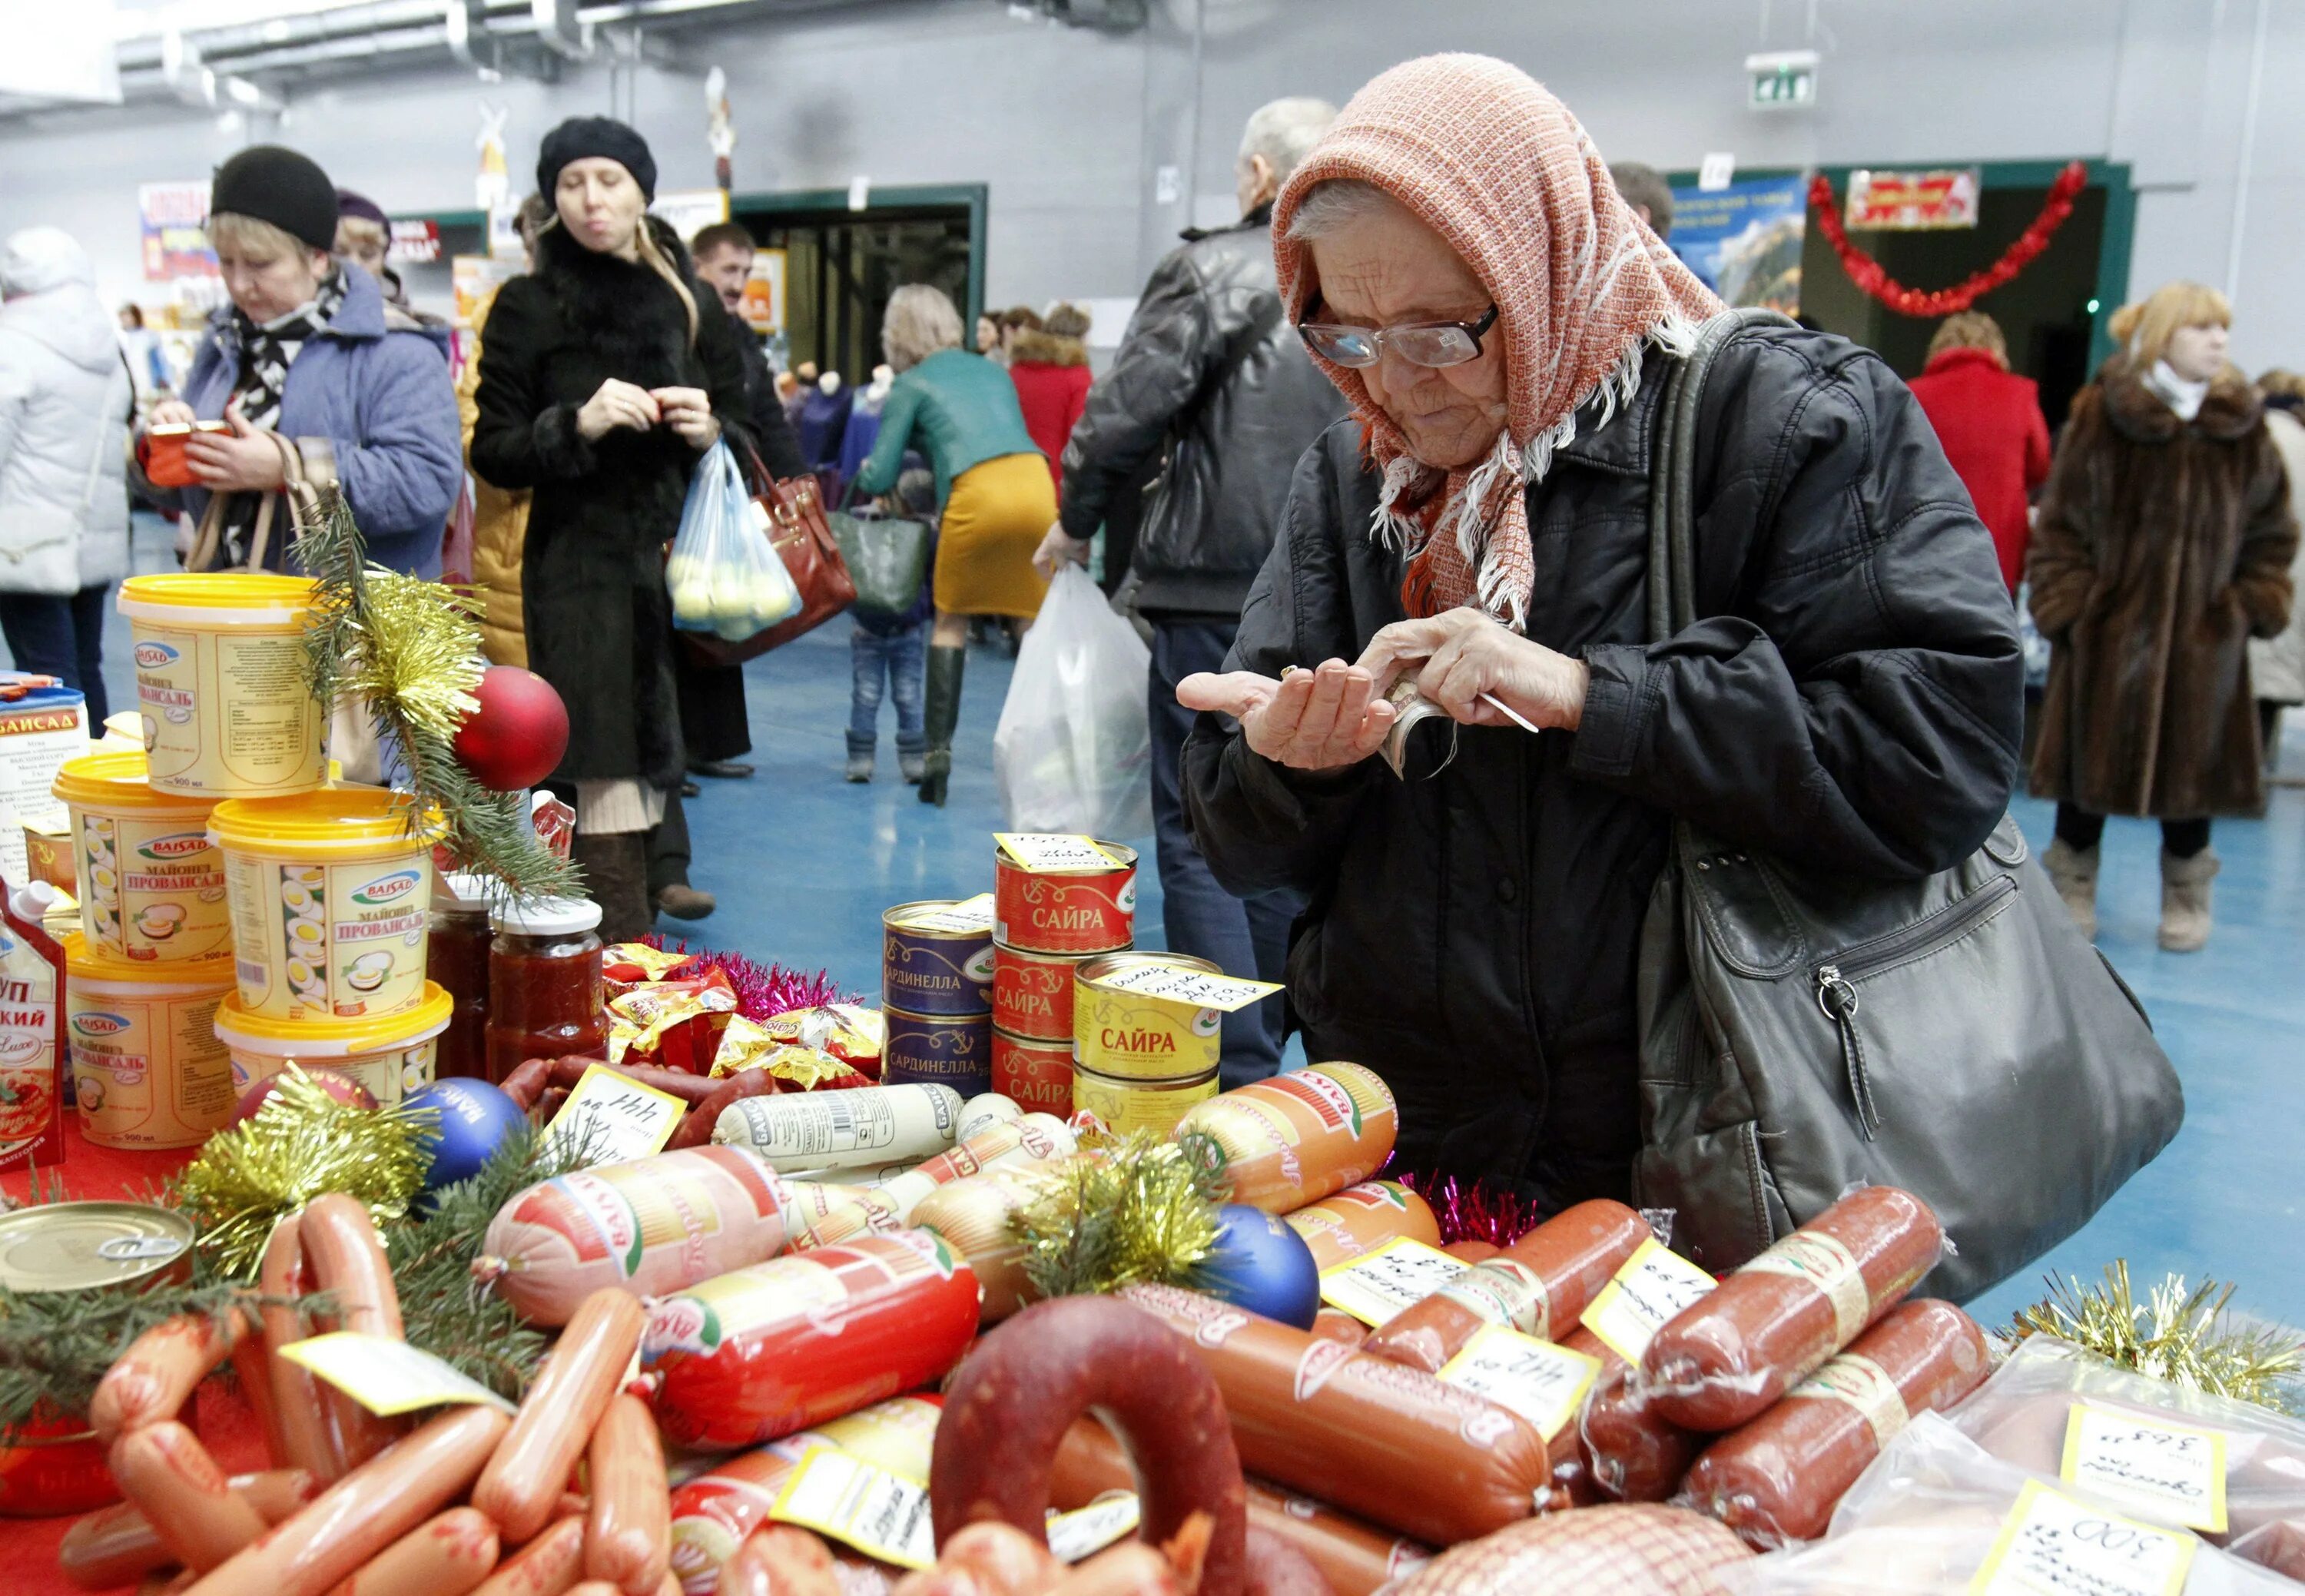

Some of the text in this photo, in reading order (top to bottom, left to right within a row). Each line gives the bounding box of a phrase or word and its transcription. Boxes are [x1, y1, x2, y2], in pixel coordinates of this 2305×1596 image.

[153, 838, 207, 852] BAISAD
[146, 863, 211, 875] МАЙОНЕЗ
[127, 872, 225, 890] ПРОВАНСАЛ
[367, 879, 413, 896] BAISAD
[358, 904, 414, 921] МАЙОНЕЗ
[1032, 905, 1105, 929] САЙРА
[997, 985, 1053, 1017] САЙРА
[1100, 1027, 1177, 1053] САЙРА
[890, 1052, 977, 1073] САРДИНЕЛЛА
[124, 1133, 141, 1142] 900
